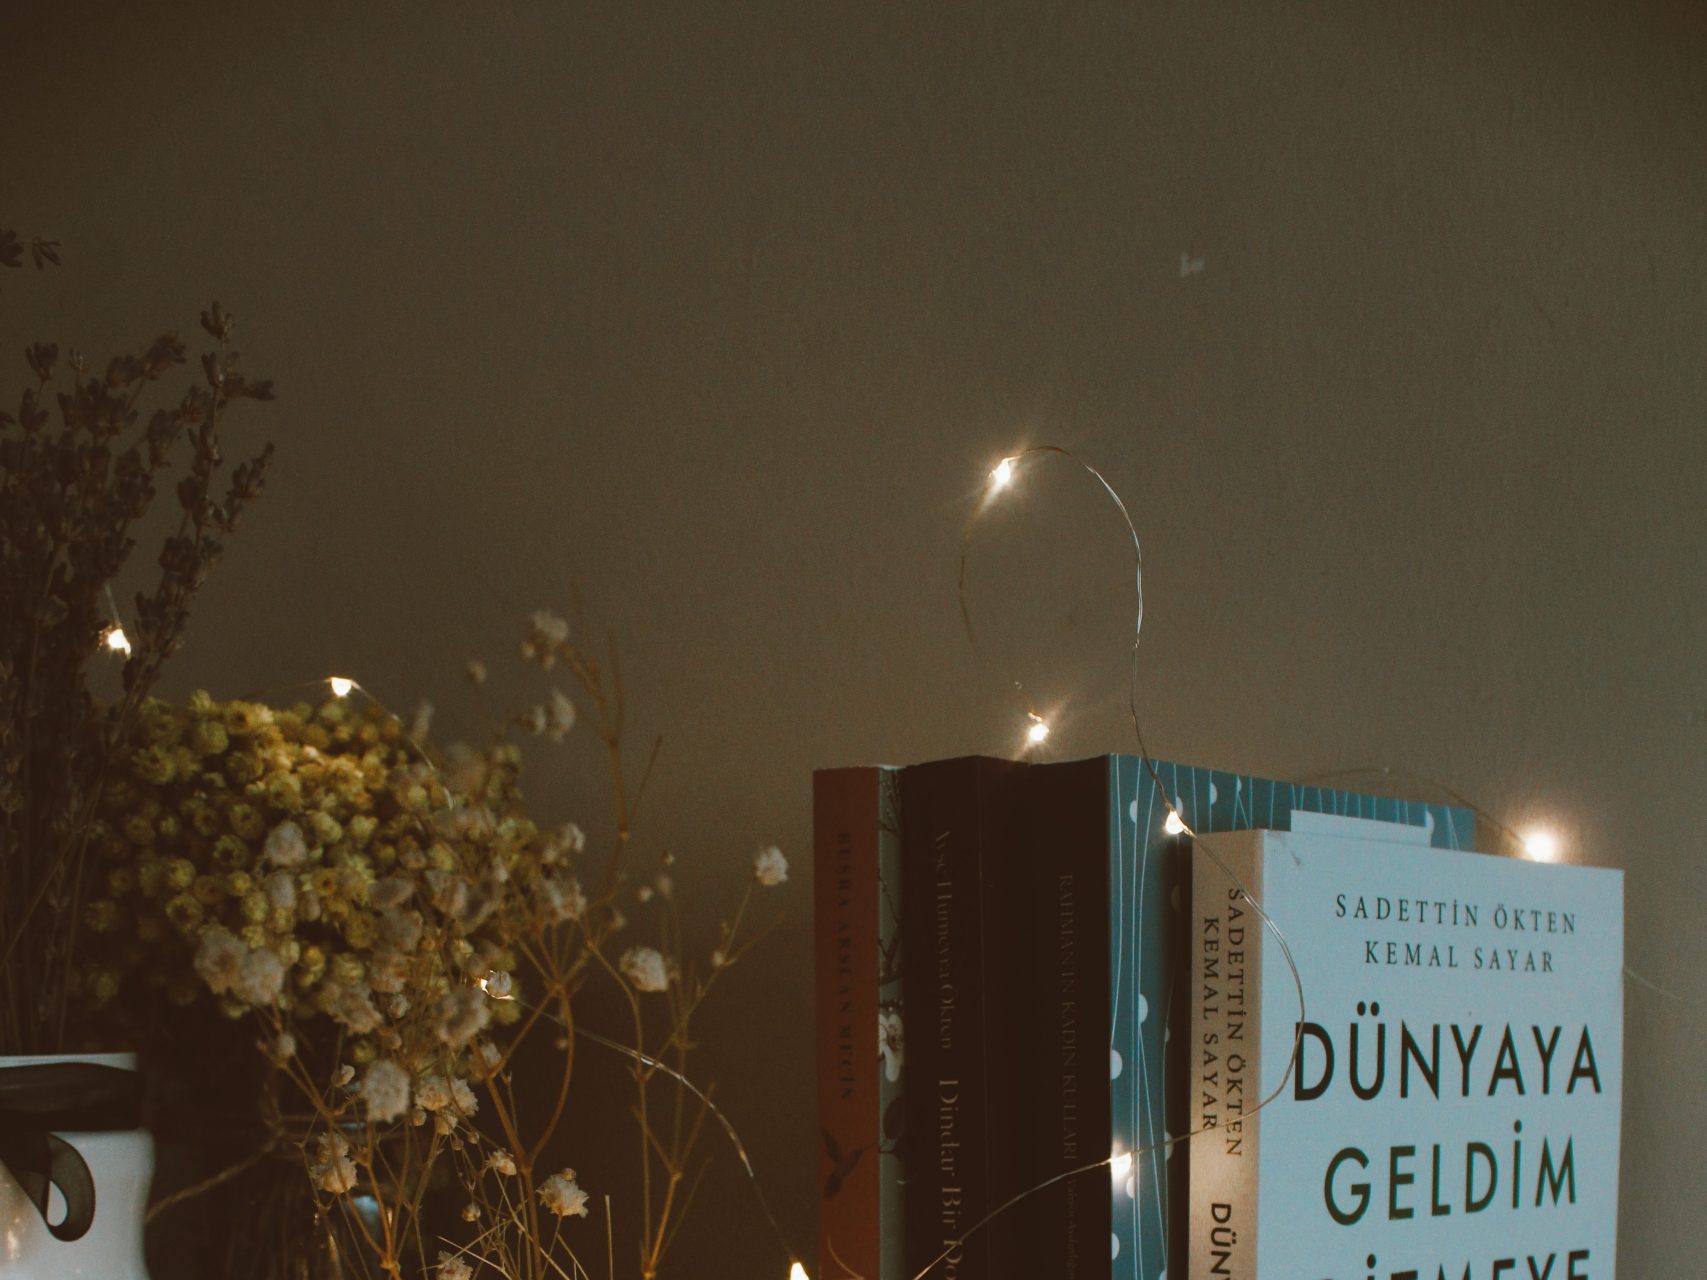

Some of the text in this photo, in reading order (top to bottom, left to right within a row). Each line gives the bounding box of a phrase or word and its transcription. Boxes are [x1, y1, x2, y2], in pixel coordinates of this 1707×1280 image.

[1335, 894, 1576, 934] SADETTİN ÖKTEN
[1364, 940, 1554, 972] KEMAL SAYAR
[1061, 1001, 1077, 1066] KADIN
[1202, 916, 1219, 1130] KEMAL SAYAR
[1226, 888, 1247, 1157] SADETTİN ÖKTEN
[1293, 1000, 1603, 1101] DÜNYAYA
[939, 1079, 961, 1177] Dindar
[1063, 1073, 1077, 1160] KULLARI
[941, 1186, 963, 1230] Bir
[1323, 1119, 1577, 1226] GELDİM
